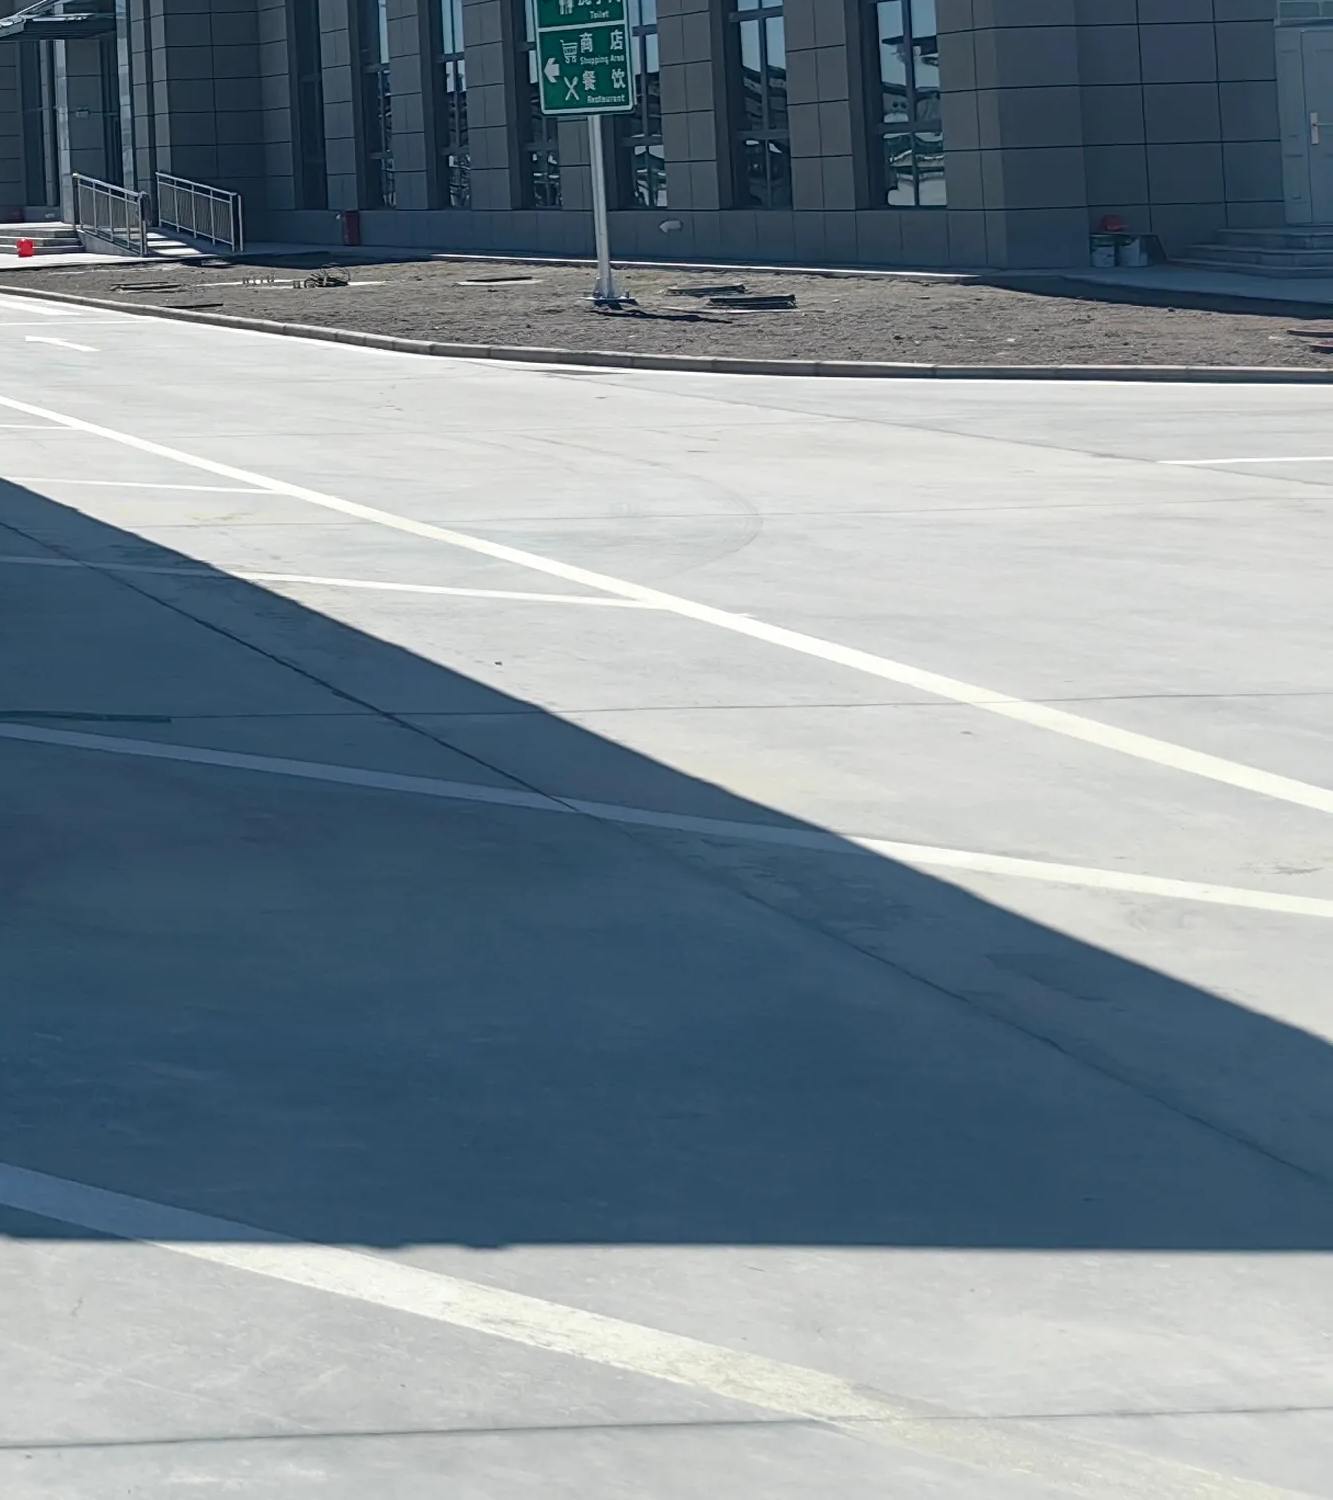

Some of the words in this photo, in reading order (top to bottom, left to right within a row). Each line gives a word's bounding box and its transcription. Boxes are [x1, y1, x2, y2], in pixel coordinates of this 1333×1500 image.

[589, 10, 609, 19] Toilet
[580, 55, 609, 66] Shopping
[610, 54, 625, 62] Area
[587, 94, 625, 104] Restaurant
